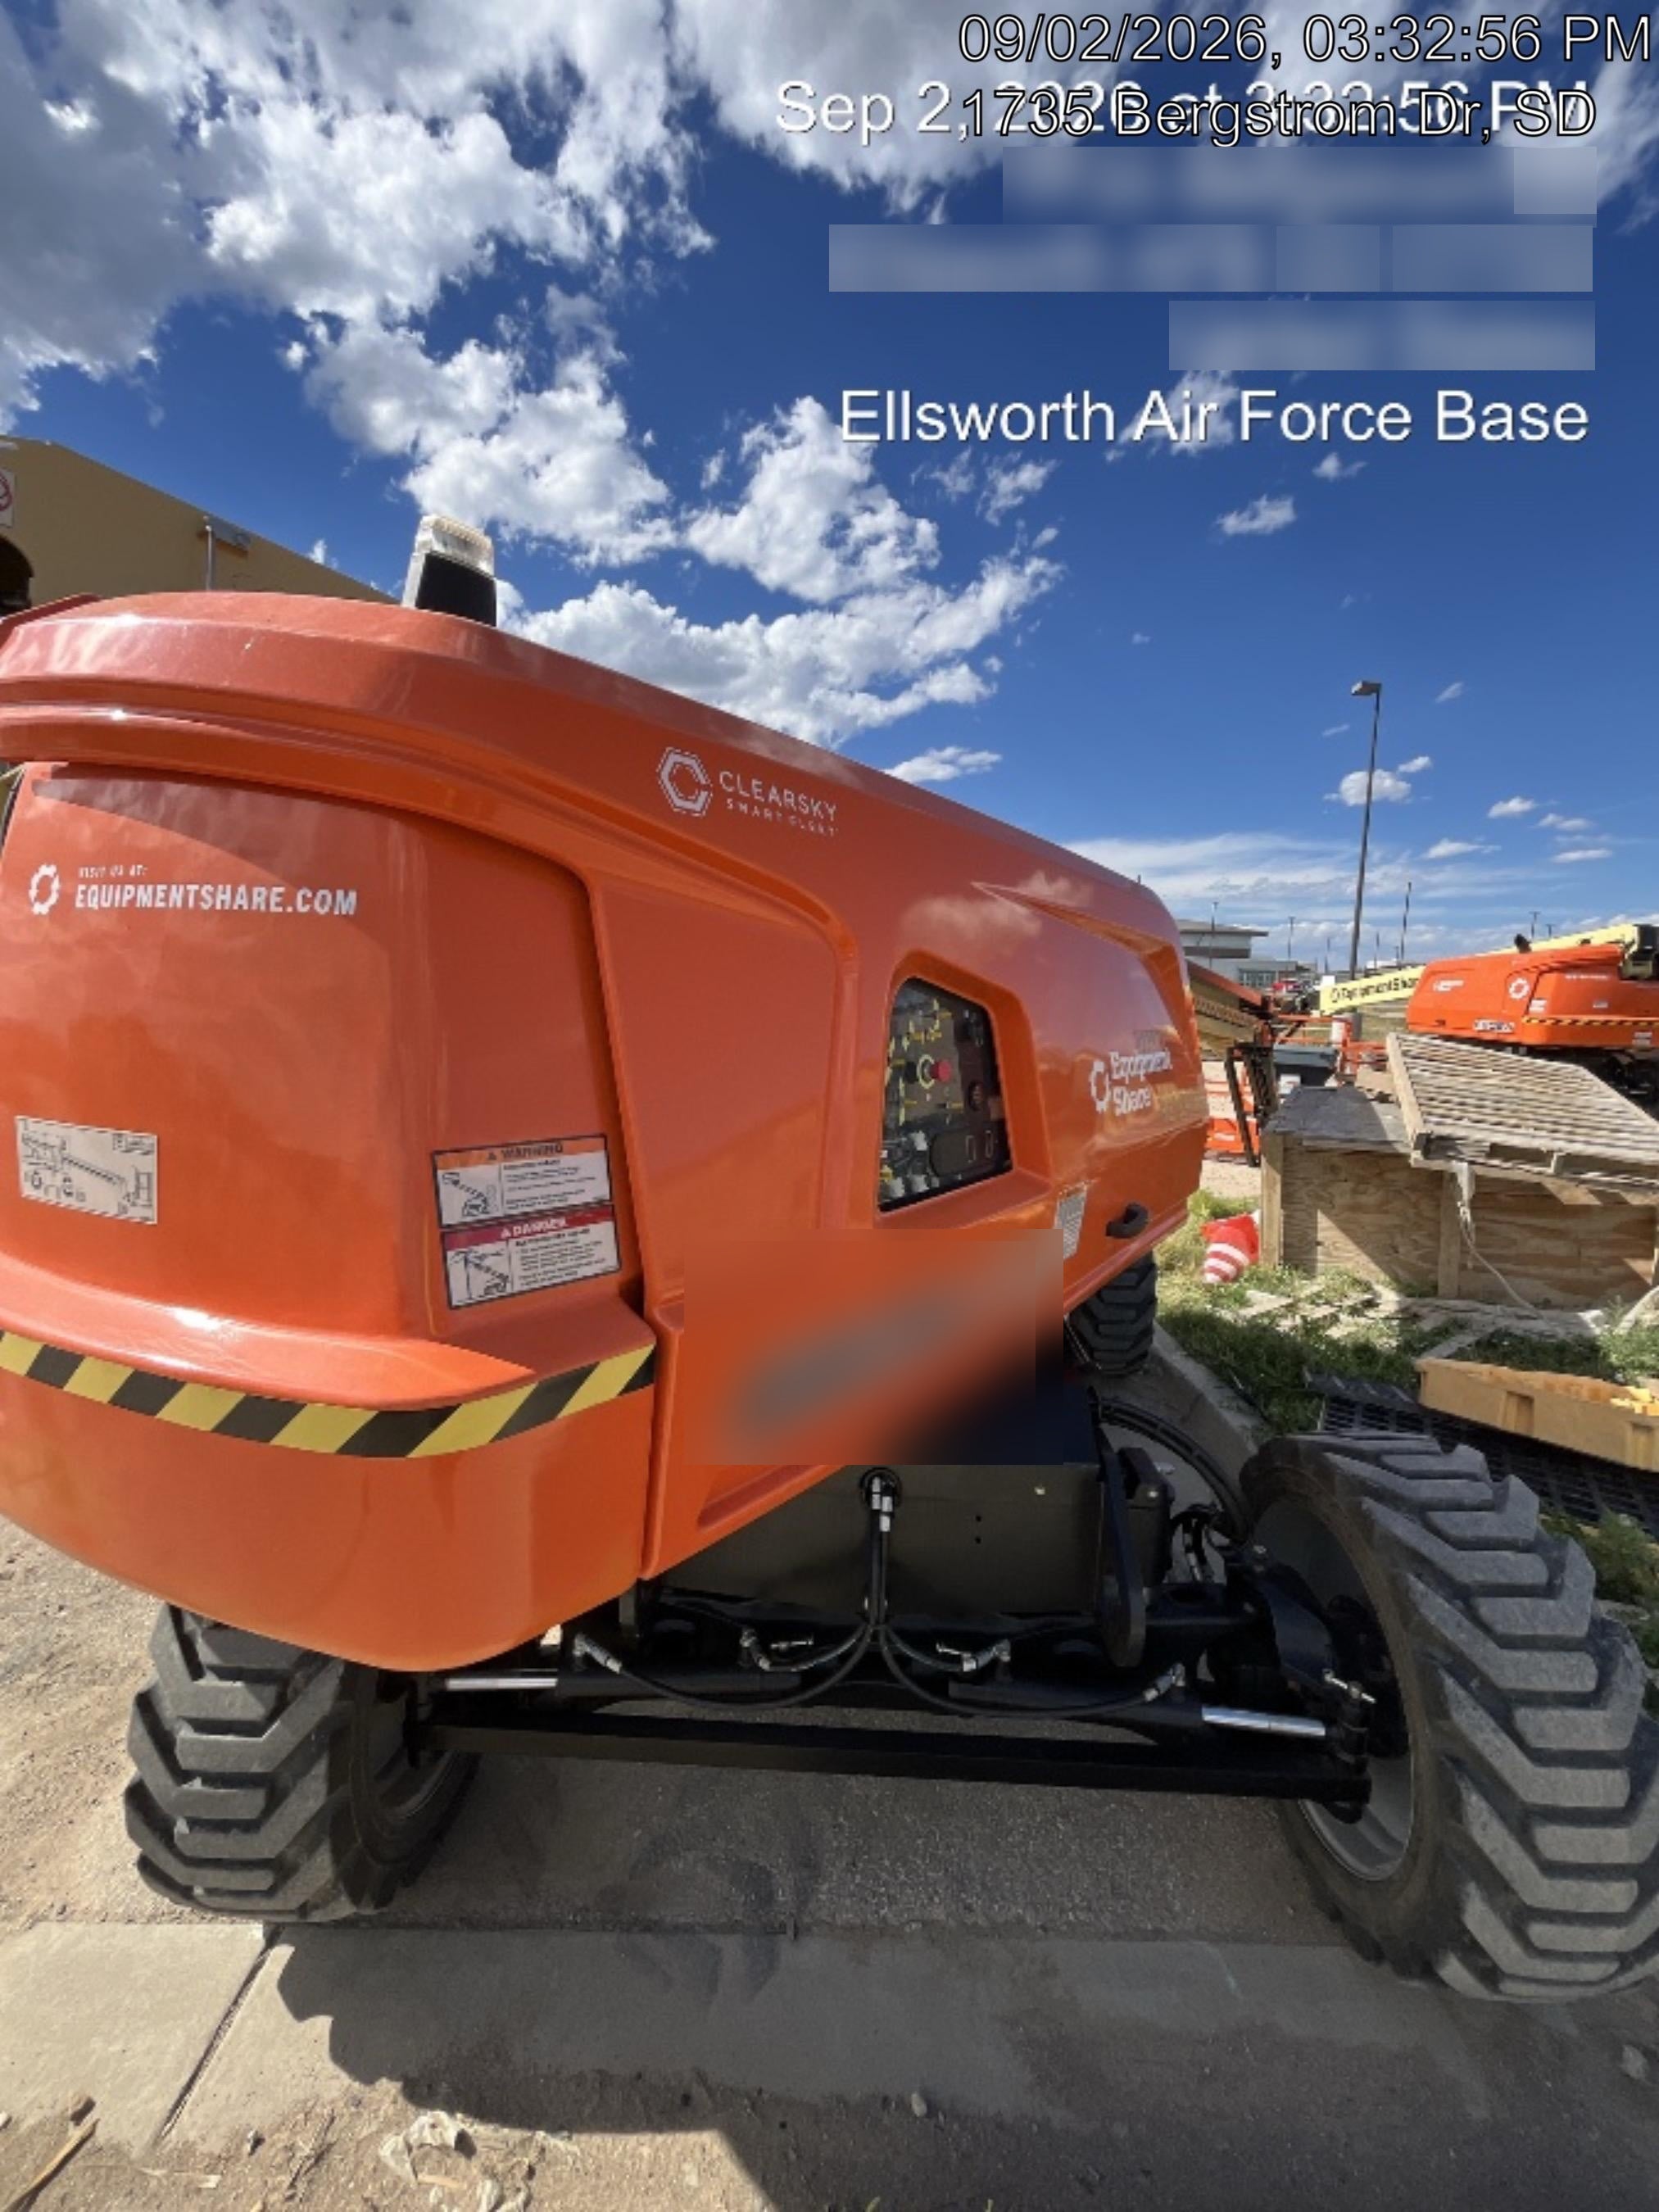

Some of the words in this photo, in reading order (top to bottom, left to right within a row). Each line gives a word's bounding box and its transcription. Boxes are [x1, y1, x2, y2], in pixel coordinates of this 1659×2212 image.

[719, 771, 837, 822] CLEARSKY
[727, 798, 783, 823] SMART
[75, 883, 358, 916] EQUIPMENTSHARE.COM
[501, 1142, 564, 1160] WARNING
[512, 1217, 568, 1238] DANGER
